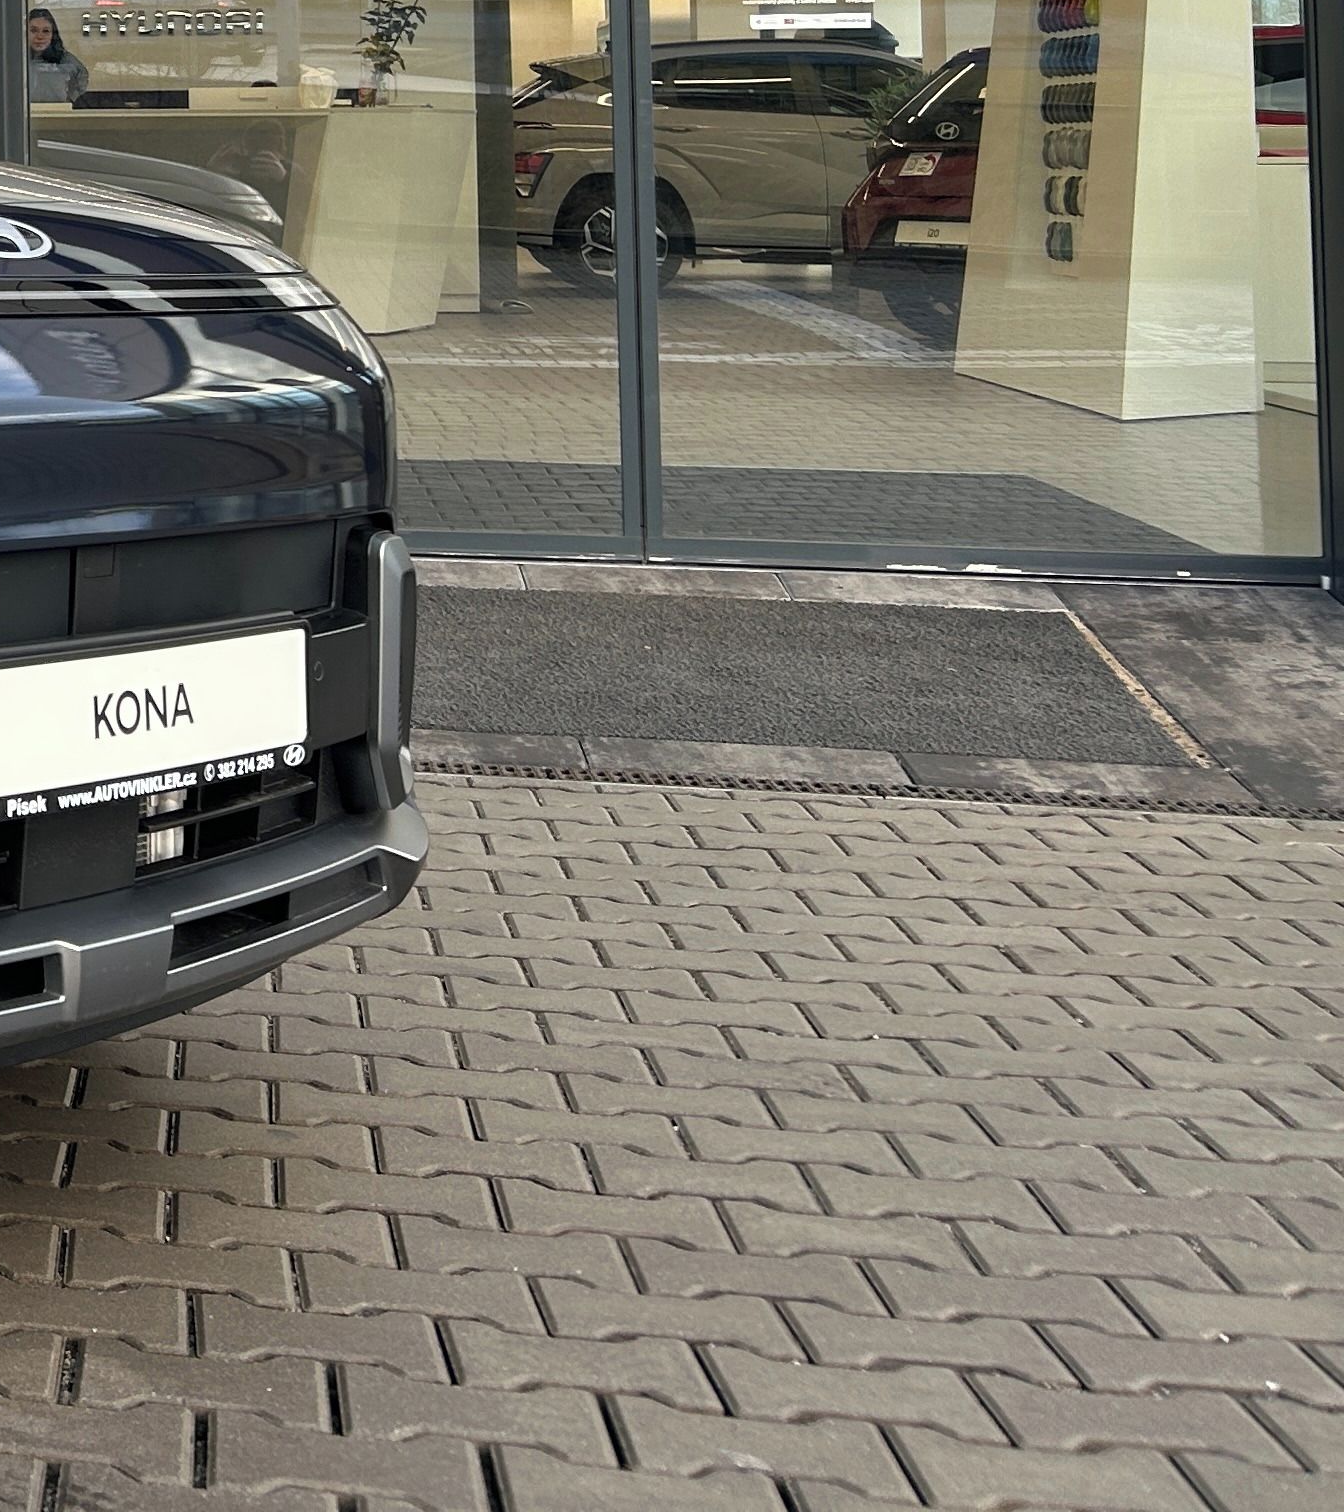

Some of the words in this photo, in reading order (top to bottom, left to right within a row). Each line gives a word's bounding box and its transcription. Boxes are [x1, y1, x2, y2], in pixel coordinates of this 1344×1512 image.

[81, 7, 265, 37] HYUNDAI
[92, 682, 195, 739] KONA
[58, 771, 197, 810] www.AUTOVINKLER.cz
[237, 756, 255, 775] 214
